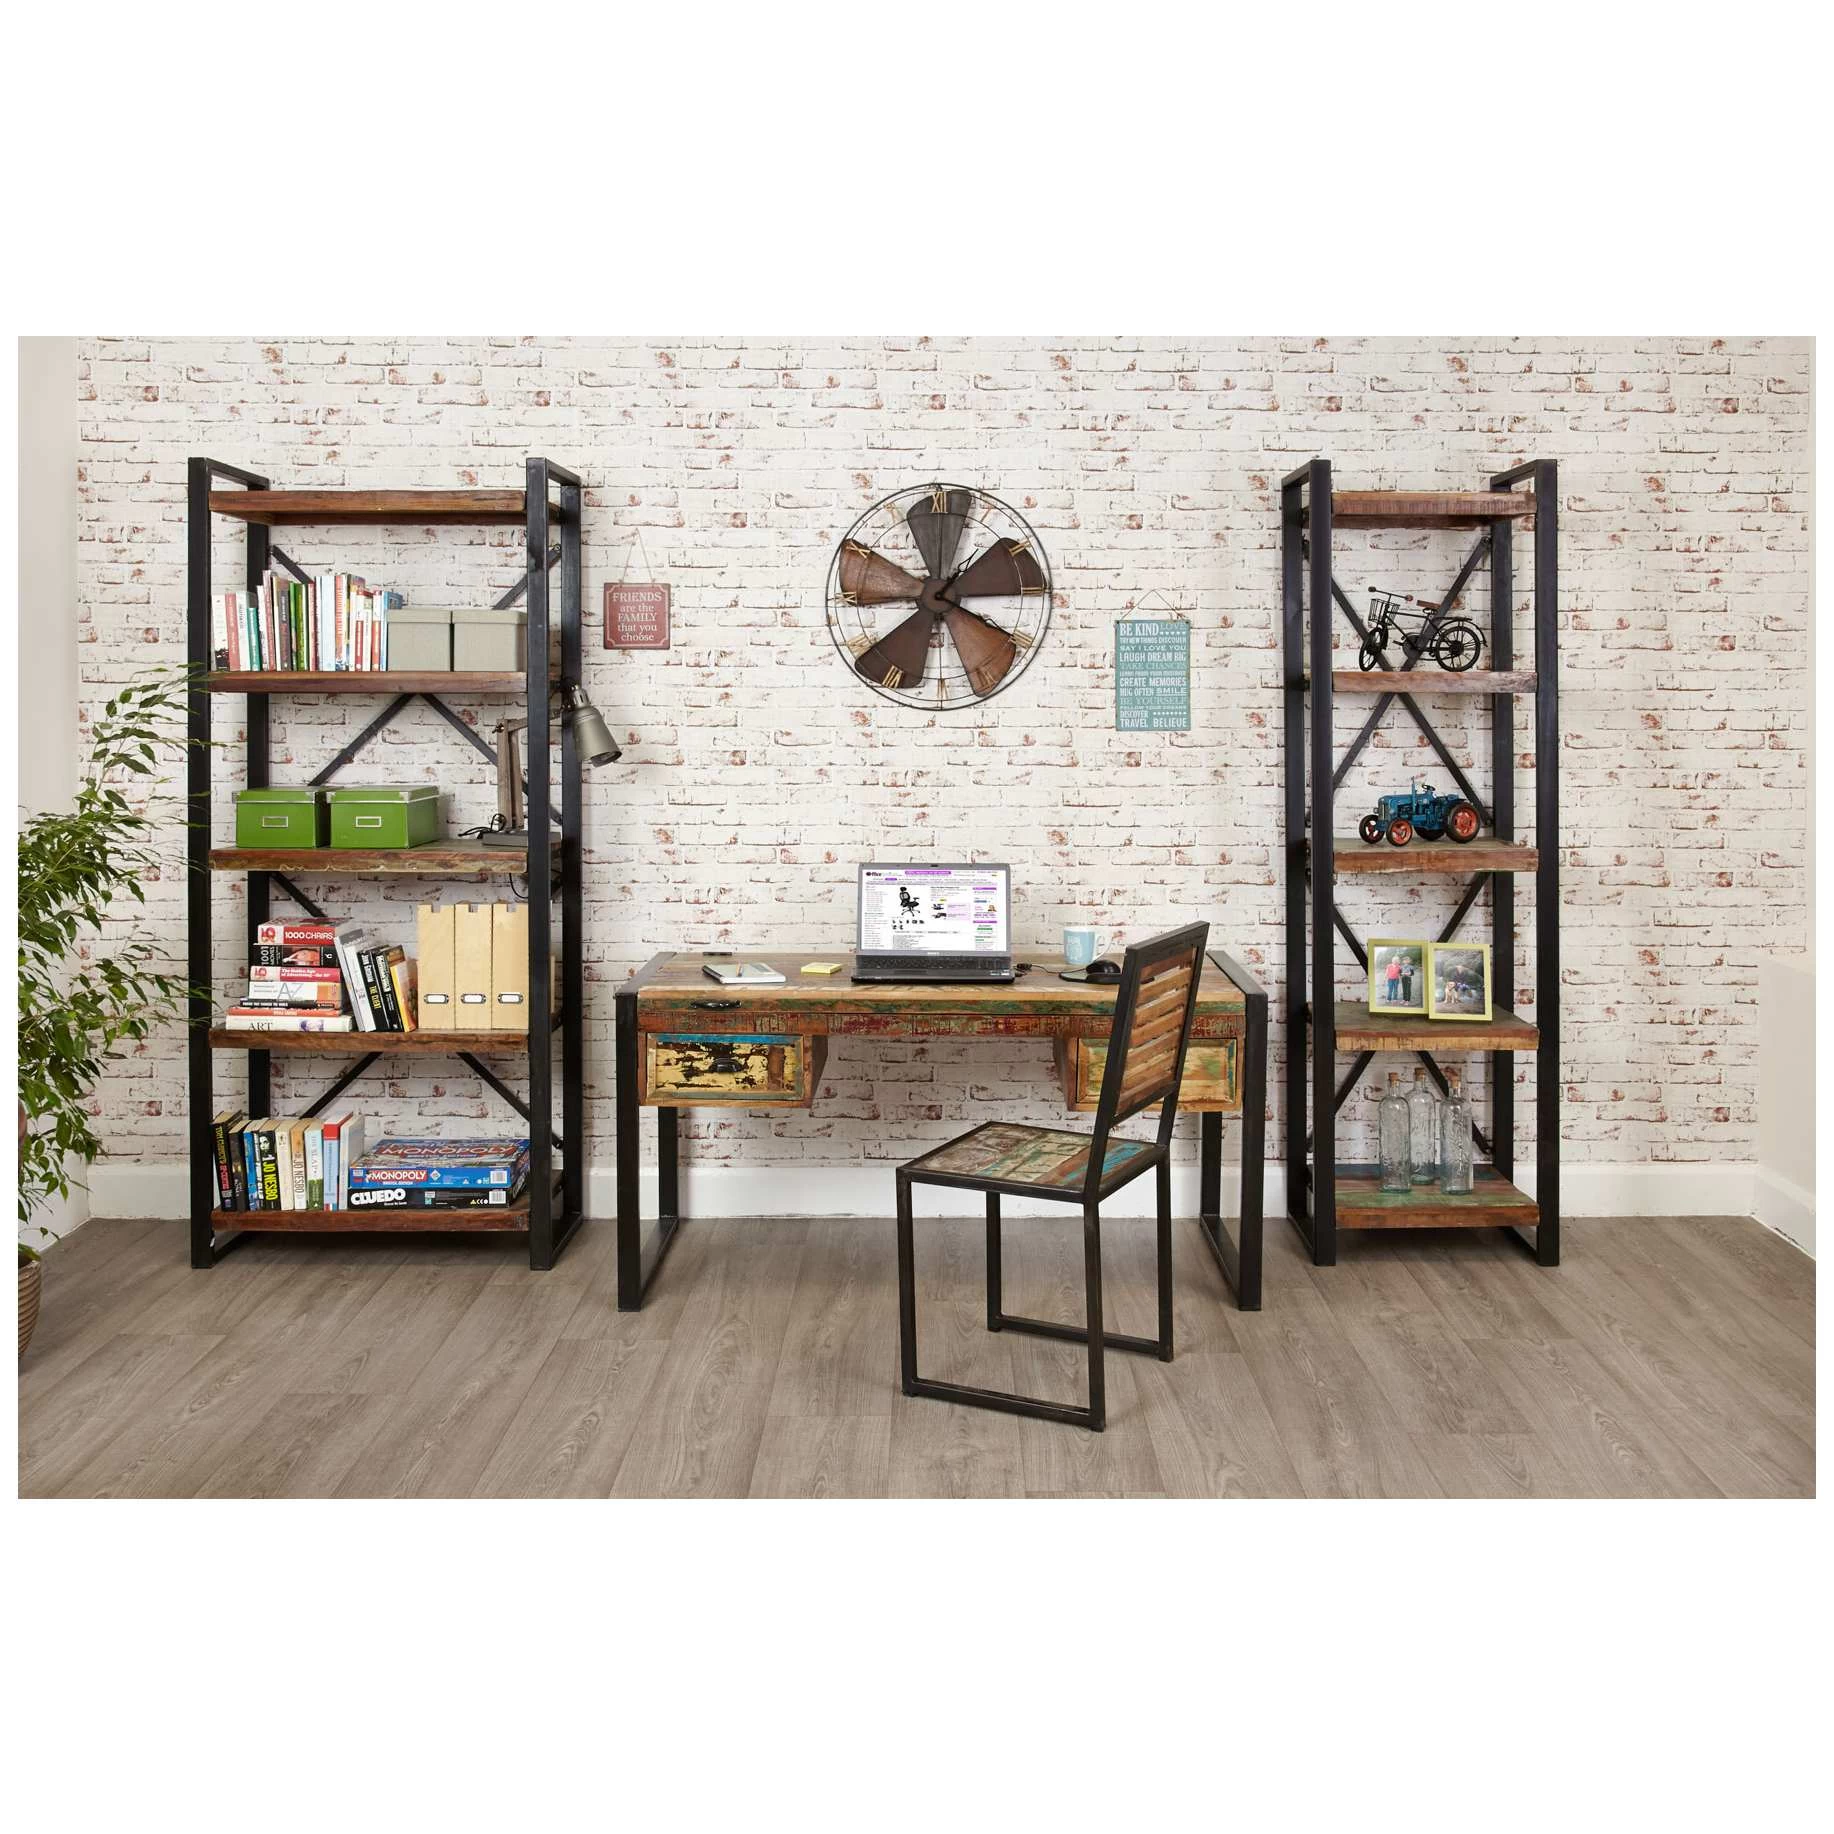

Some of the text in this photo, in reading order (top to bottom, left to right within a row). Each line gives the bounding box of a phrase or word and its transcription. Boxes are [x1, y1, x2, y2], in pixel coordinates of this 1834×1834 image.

[613, 592, 662, 602] FRIENDS
[638, 603, 654, 612] the
[618, 612, 656, 622] FAMILY
[618, 623, 657, 635] that you
[1120, 623, 1132, 636] BE
[1136, 623, 1159, 636] KIND
[620, 632, 654, 641] choose
[1120, 652, 1186, 662] LAUGH DREAM BIG
[1120, 678, 1186, 687] CREATE MEMORIES
[1134, 688, 1154, 696] OFTEN
[1120, 710, 1148, 718] DISCOVER
[1120, 718, 1187, 728] TRAVEL BELIEVE
[285, 931, 334, 940] 1000 CHAIRS
[260, 946, 269, 966] 1001
[249, 1022, 272, 1030] ART
[383, 1146, 514, 1154] MONOPOLY
[263, 1162, 276, 1174] JO
[293, 1160, 304, 1172] JO
[372, 1171, 426, 1181] MONOPOLY
[350, 1188, 406, 1206] CLUEDO
